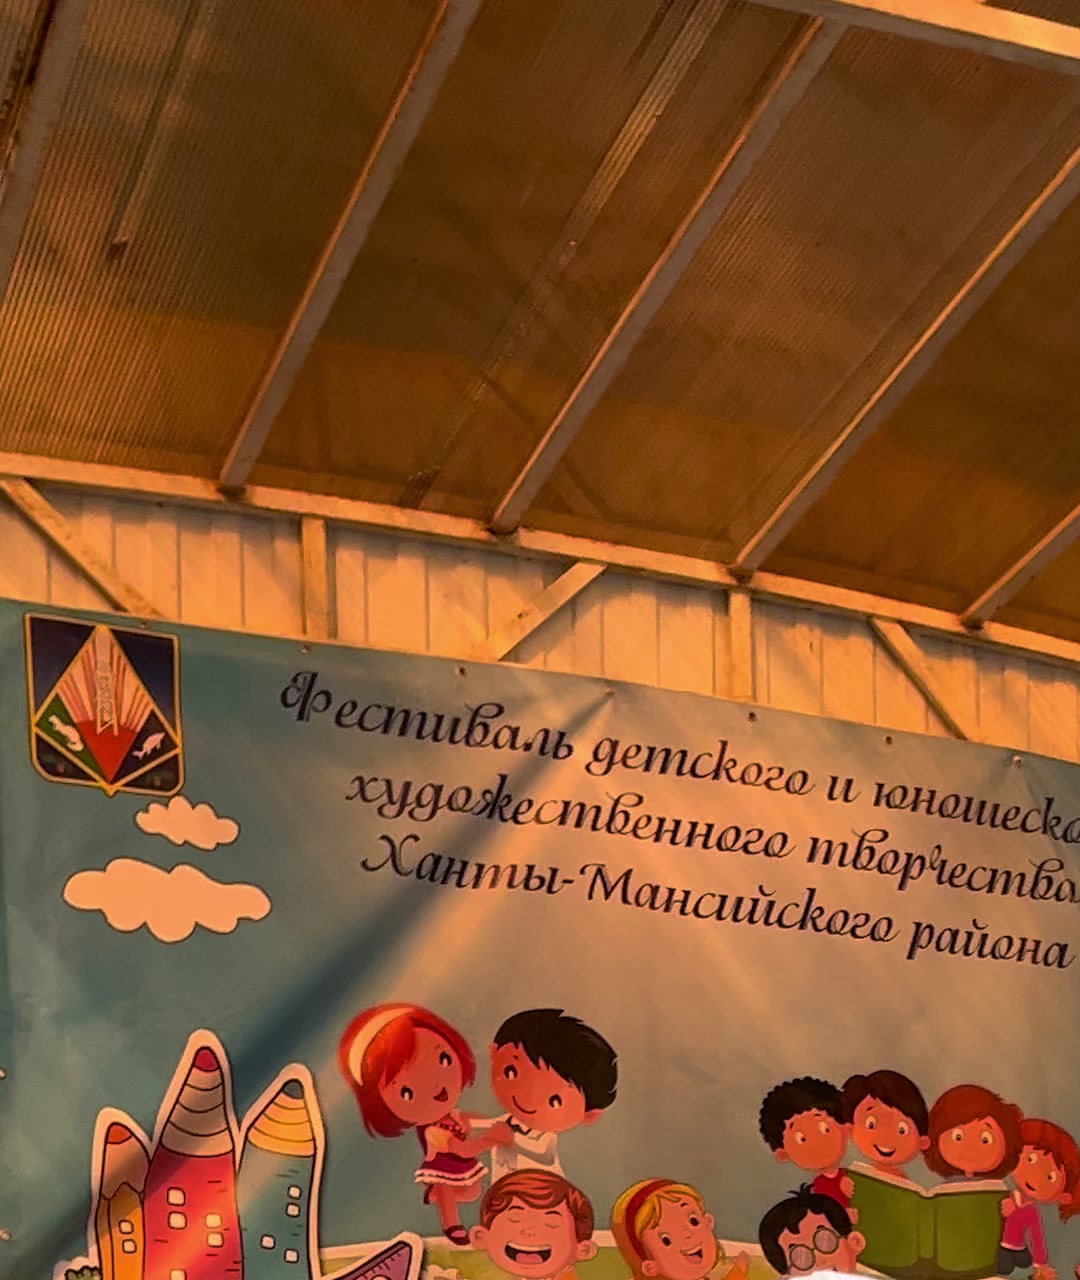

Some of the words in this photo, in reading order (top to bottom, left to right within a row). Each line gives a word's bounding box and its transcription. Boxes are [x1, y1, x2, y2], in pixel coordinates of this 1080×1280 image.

[280, 671, 574, 760] Фестиваль
[585, 737, 816, 797] детского
[826, 774, 861, 803] и
[345, 773, 796, 858] художественного
[806, 828, 1080, 904] творчества
[360, 834, 901, 943] Ханты-Мансийского
[906, 918, 1076, 969] района
